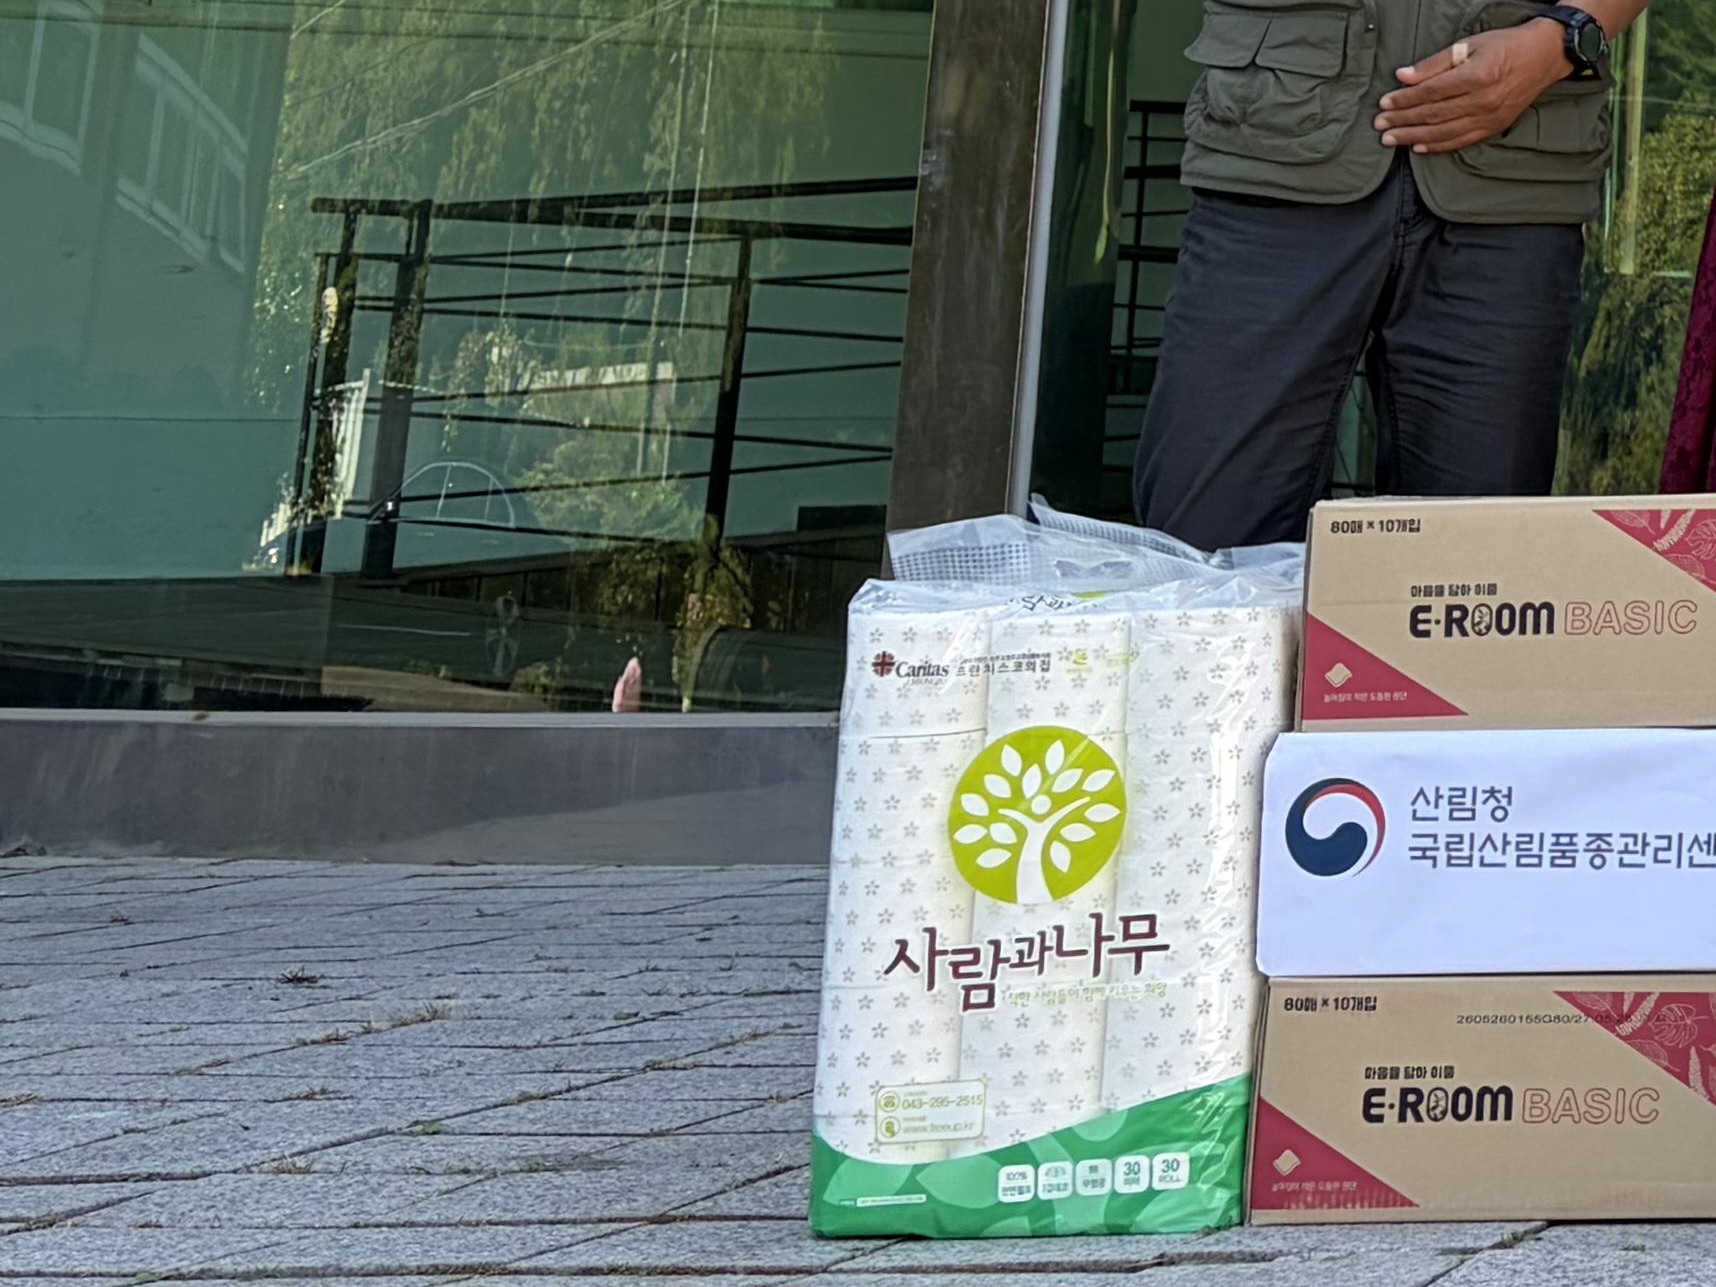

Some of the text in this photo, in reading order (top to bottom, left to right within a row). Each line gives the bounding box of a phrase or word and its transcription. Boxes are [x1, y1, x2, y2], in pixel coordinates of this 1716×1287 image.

[1564, 599, 1698, 635] BASIC
[896, 661, 949, 678] Caritas
[1410, 786, 1513, 823] 산림청
[884, 913, 1170, 1012] 사람과나무
[1522, 1087, 1660, 1124] BASIC
[1123, 1161, 1140, 1176] 30
[1161, 1158, 1180, 1173] 30
